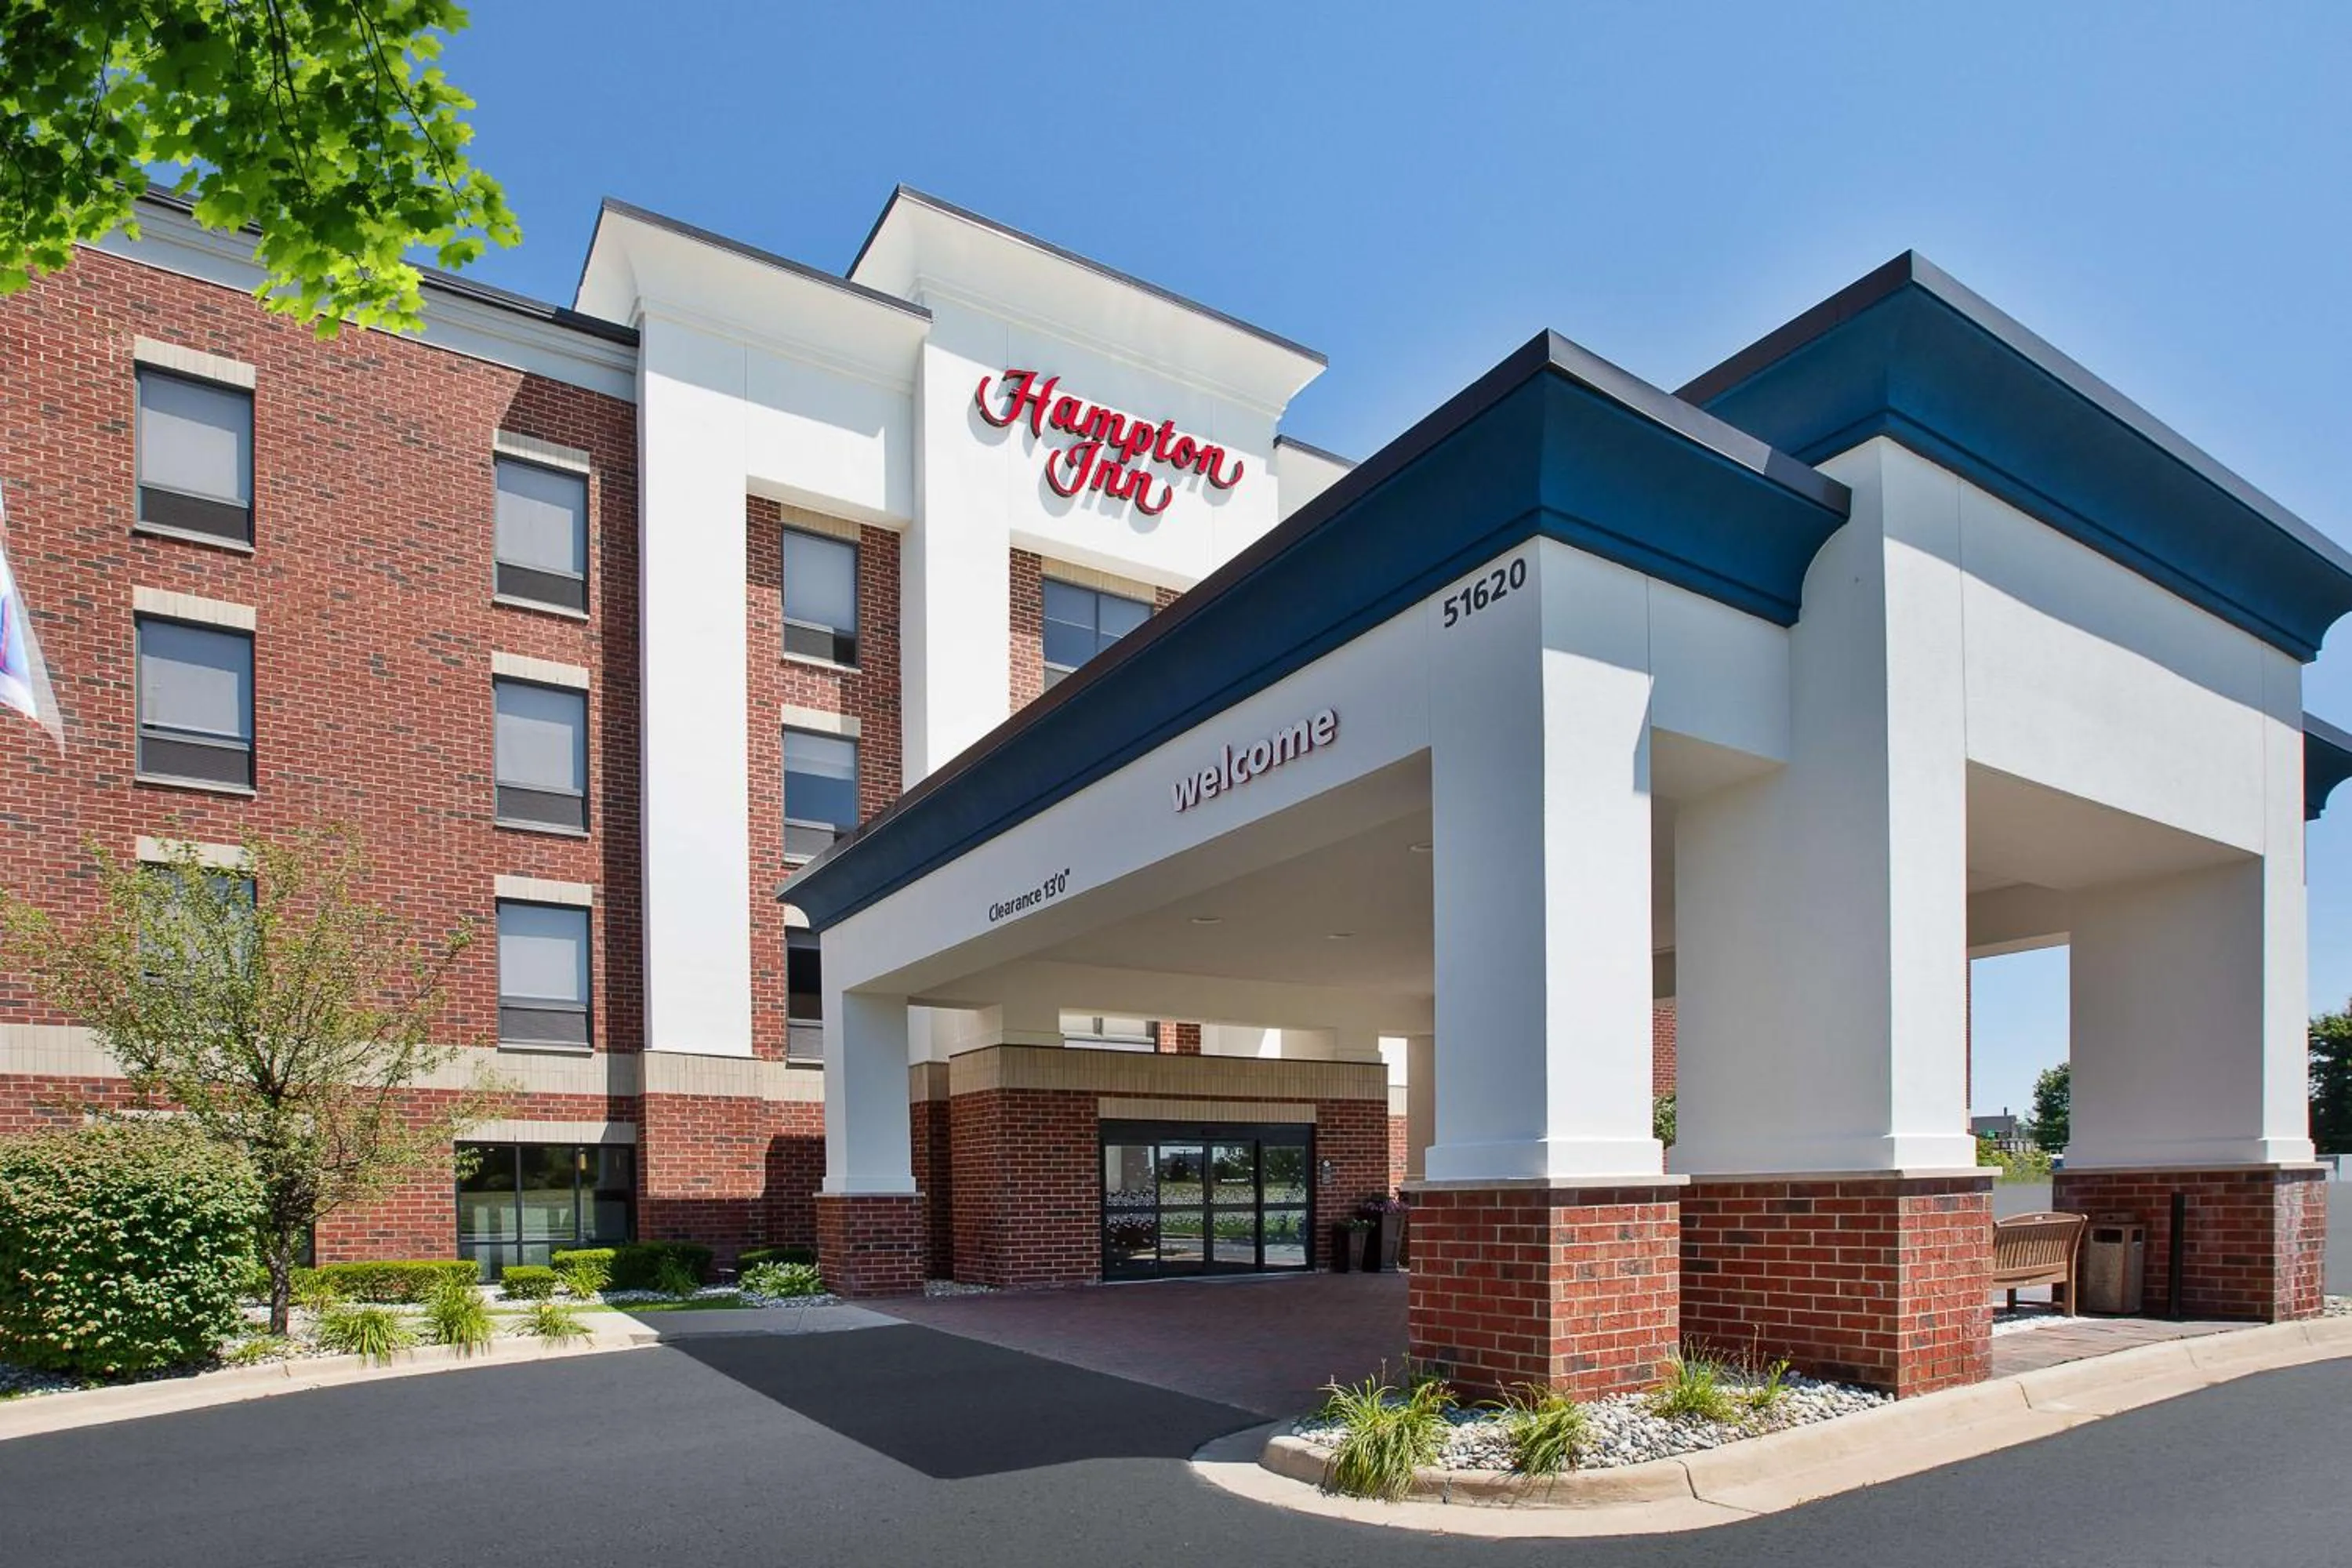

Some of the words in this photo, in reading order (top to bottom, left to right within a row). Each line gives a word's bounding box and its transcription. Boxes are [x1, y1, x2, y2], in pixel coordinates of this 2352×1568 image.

[975, 369, 1243, 489] Hampton
[1045, 441, 1172, 515] Inn
[1443, 558, 1526, 627] 51620
[1171, 707, 1338, 812] welcome
[989, 888, 1042, 922] Clearance
